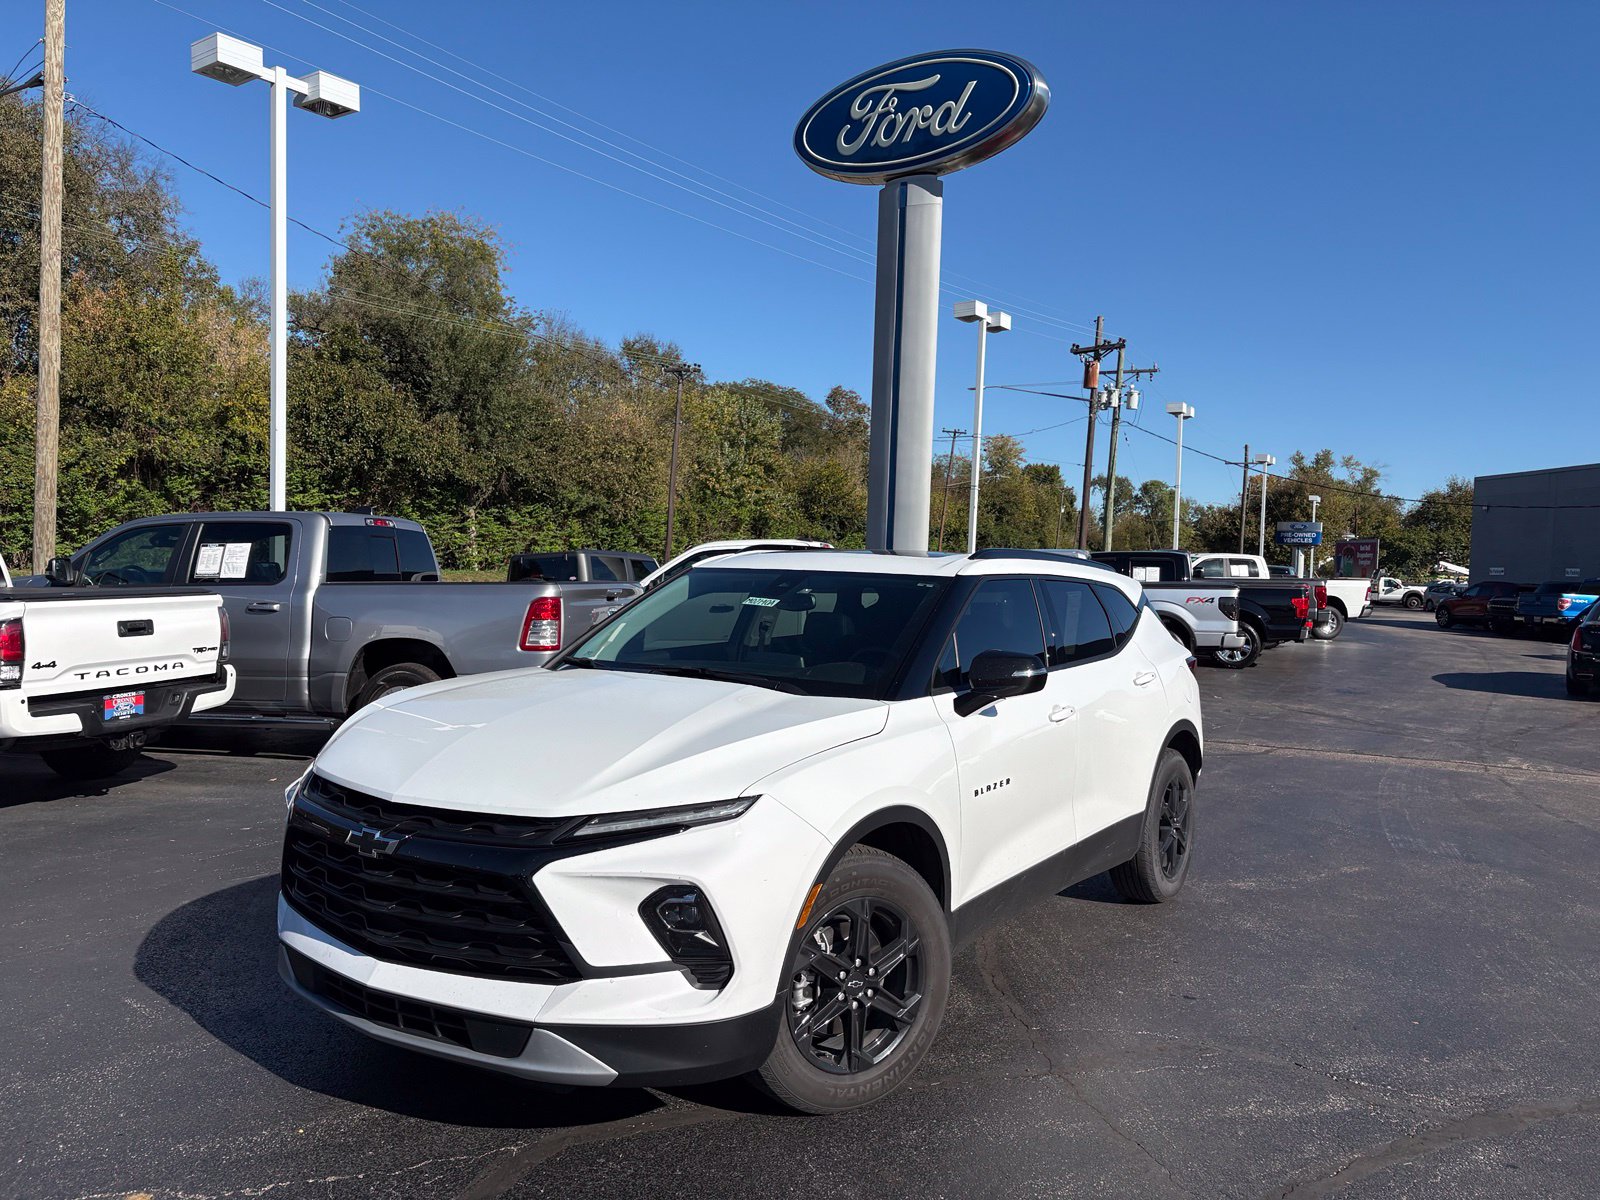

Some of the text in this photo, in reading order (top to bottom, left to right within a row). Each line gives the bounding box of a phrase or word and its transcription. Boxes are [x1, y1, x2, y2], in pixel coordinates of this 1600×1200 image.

[837, 74, 978, 155] Ford
[1186, 596, 1215, 604] FX4
[192, 646, 207, 654] TRD
[74, 662, 184, 680] TACOMA
[112, 697, 136, 707] CRONIN
[113, 708, 136, 717] NORTH
[974, 777, 1010, 797] BLAZER
[826, 1019, 934, 1098] CONTINENTAL
